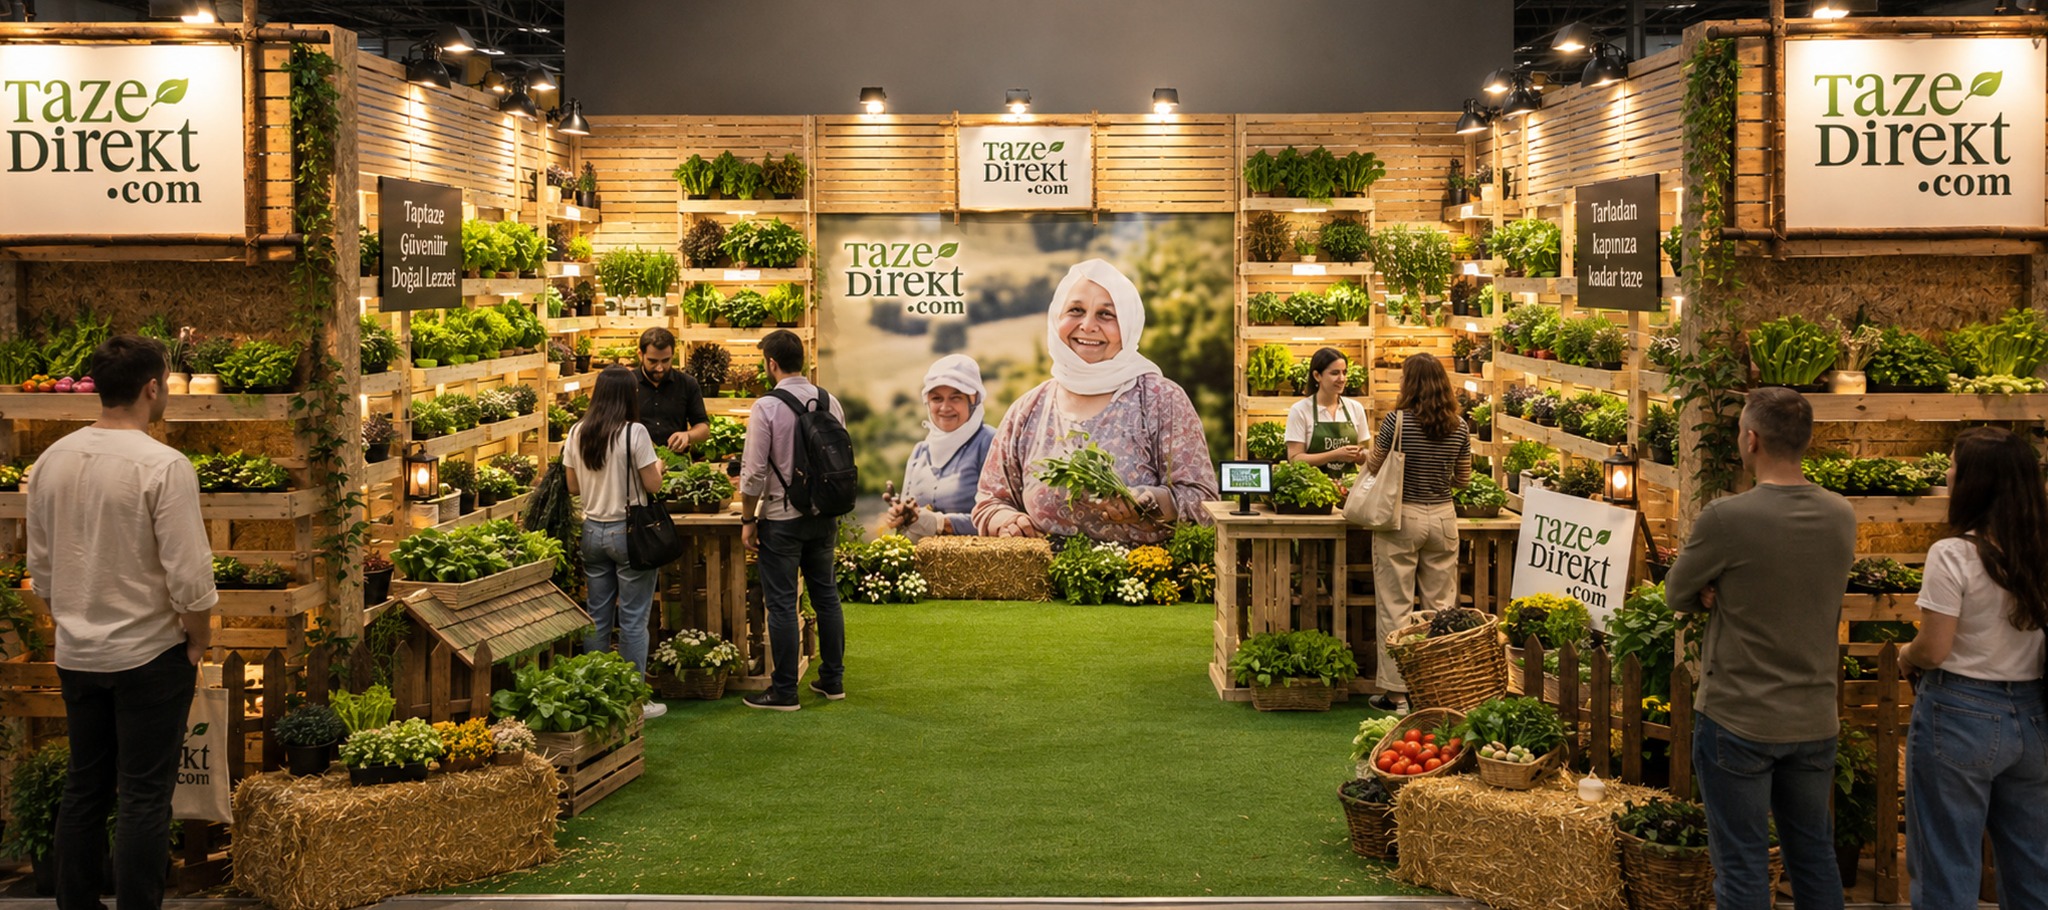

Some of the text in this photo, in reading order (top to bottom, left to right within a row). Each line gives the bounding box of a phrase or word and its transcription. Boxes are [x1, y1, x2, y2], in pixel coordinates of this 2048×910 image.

[4, 79, 150, 123] Taze
[1814, 72, 1964, 117] Taze
[983, 141, 1047, 161] Taze
[403, 200, 445, 229] Taptaze
[1591, 198, 1637, 223] Tarladan
[844, 242, 934, 268] Taze
[1592, 232, 1637, 259] kapınıza
[391, 266, 457, 294] Doğal Lezzet
[1588, 265, 1643, 288] kadar taze
[1534, 513, 1594, 552] Taze
